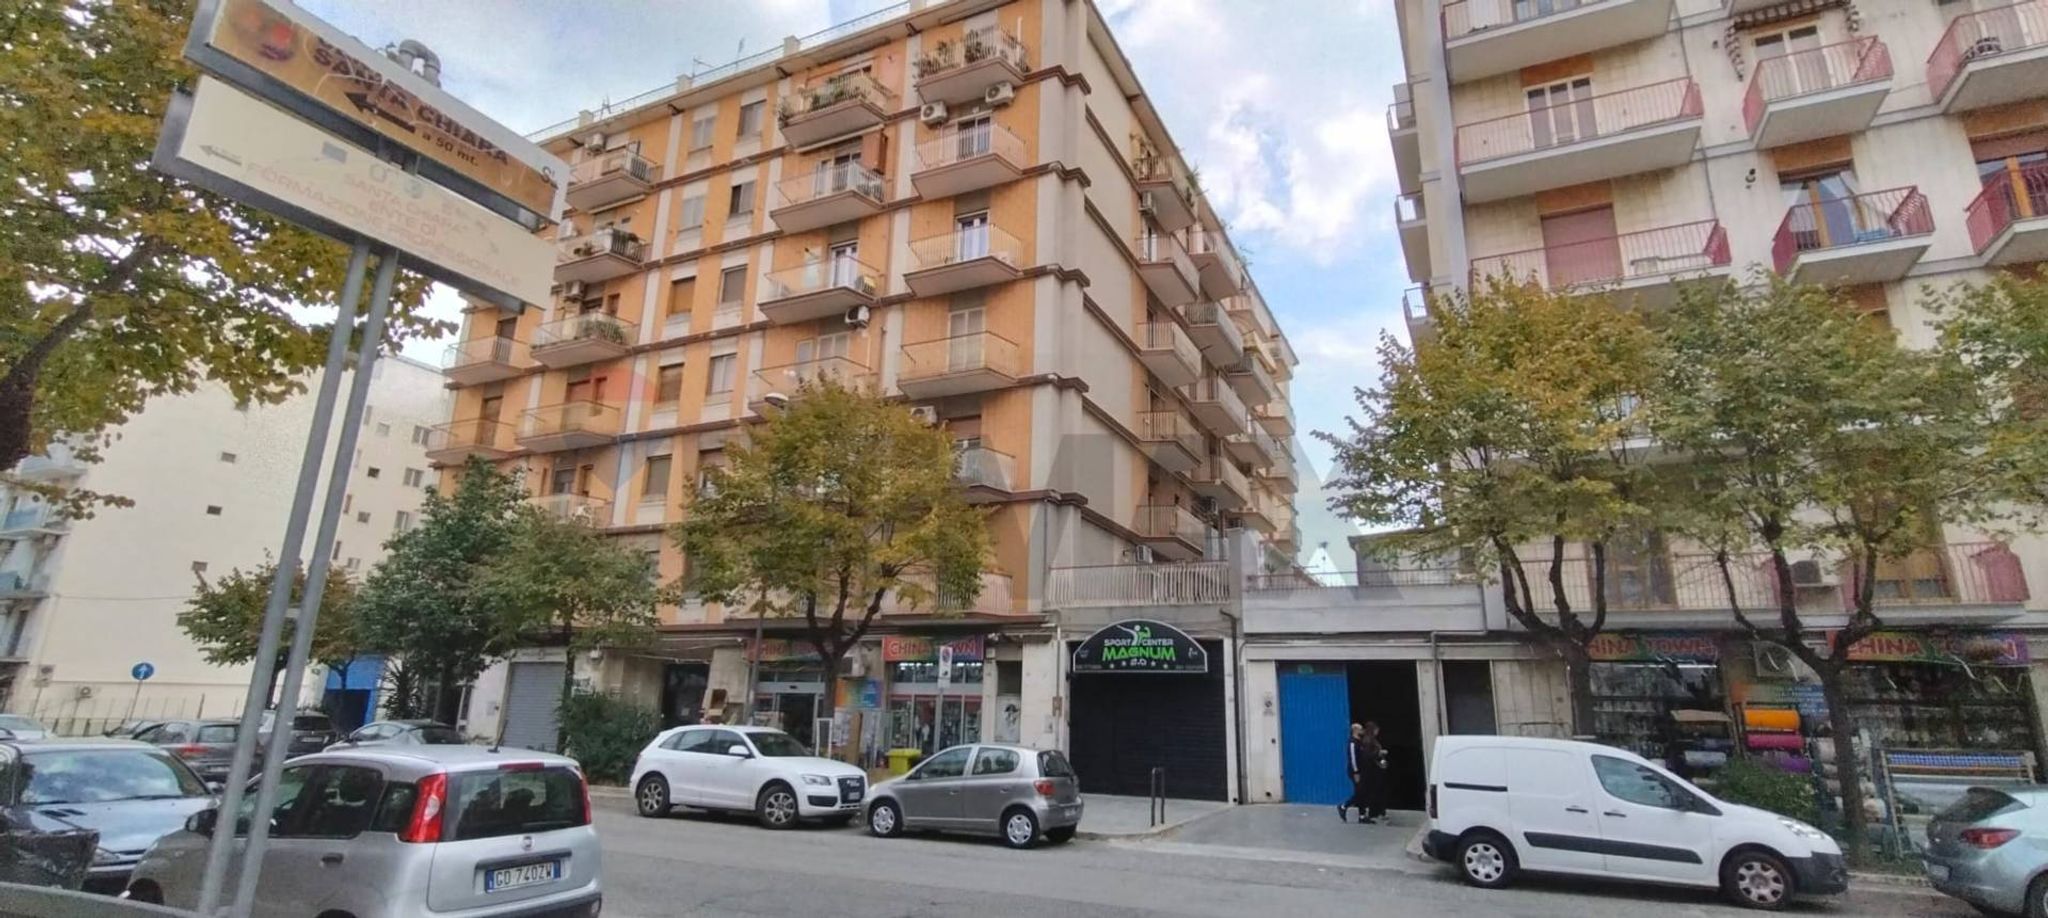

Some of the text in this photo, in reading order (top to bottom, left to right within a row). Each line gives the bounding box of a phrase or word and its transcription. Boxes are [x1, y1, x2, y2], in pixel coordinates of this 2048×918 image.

[414, 104, 511, 165] CHIARA
[435, 137, 454, 153] 50
[1102, 646, 1176, 661] MAGNUM
